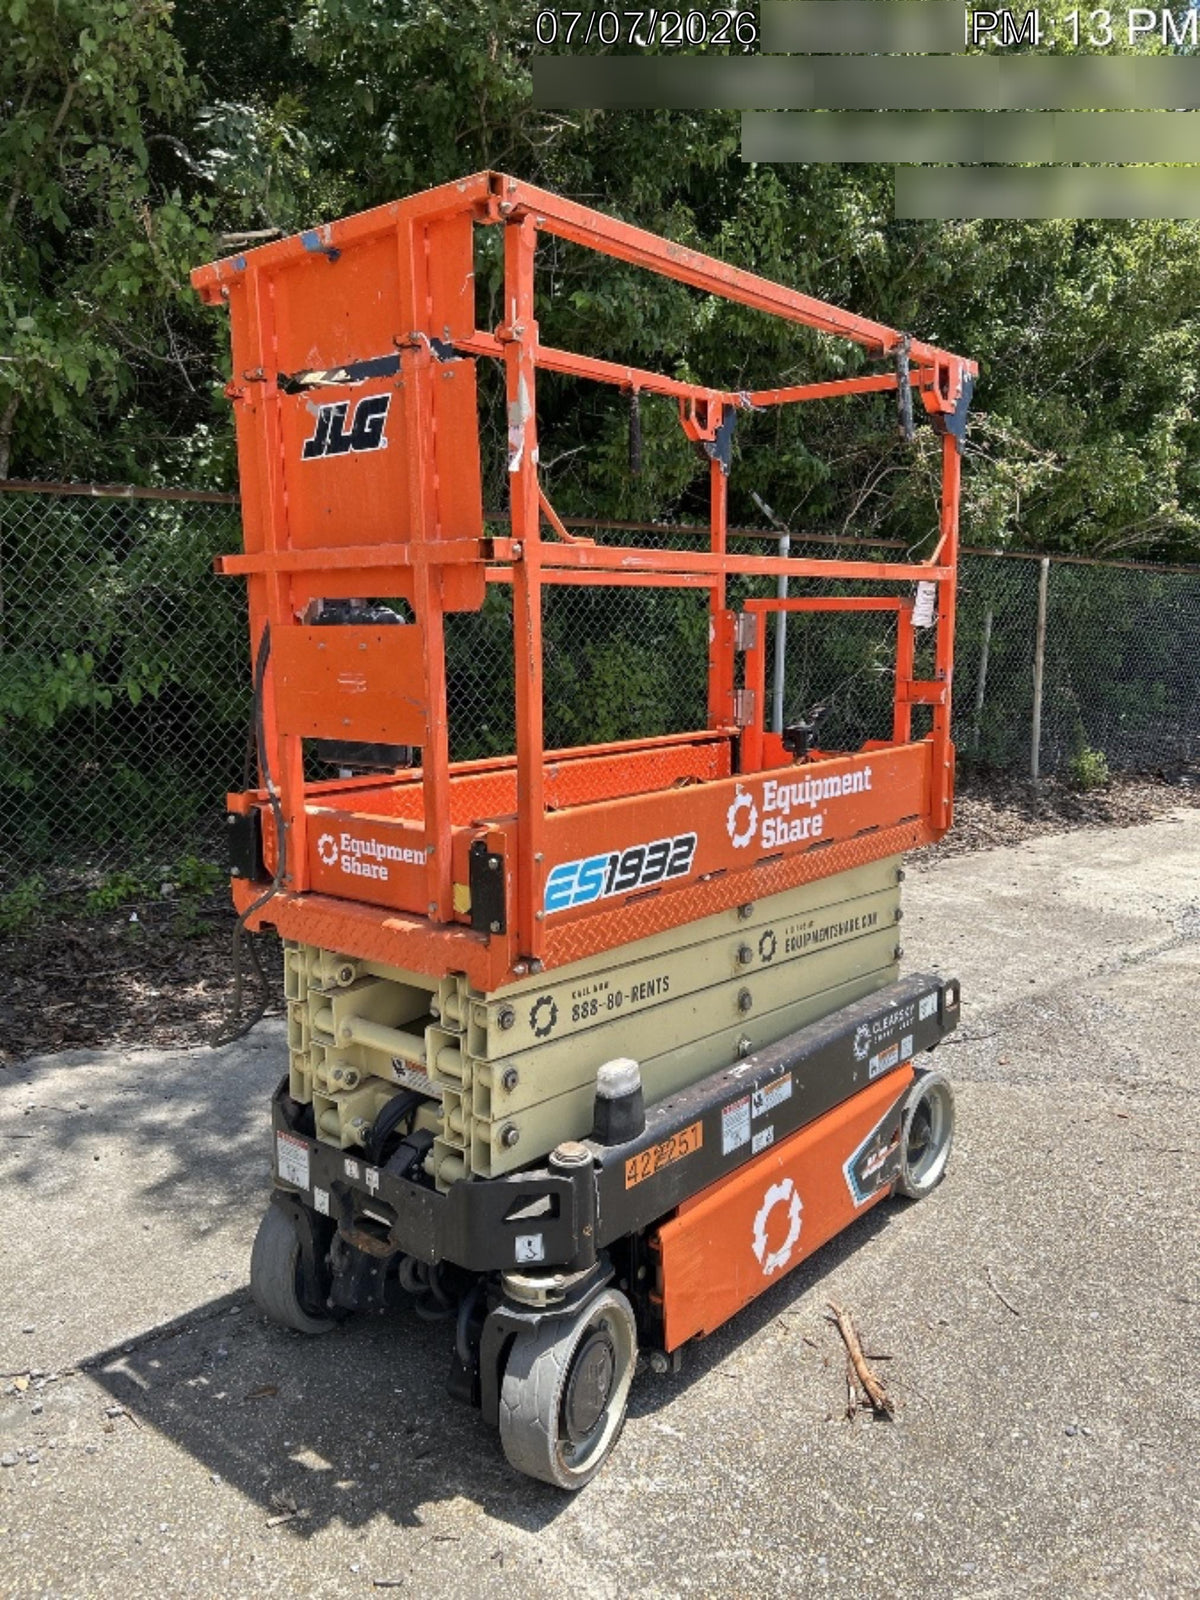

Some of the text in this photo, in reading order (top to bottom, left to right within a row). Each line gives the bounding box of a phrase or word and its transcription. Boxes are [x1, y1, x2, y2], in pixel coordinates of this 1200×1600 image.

[301, 392, 392, 461] JLG
[762, 766, 872, 815] Equipment
[340, 832, 427, 865] Equipmen
[761, 813, 823, 849] Share
[340, 854, 389, 880] Share
[544, 832, 698, 914] ES1932
[571, 975, 670, 1023] 888-80-RENTS
